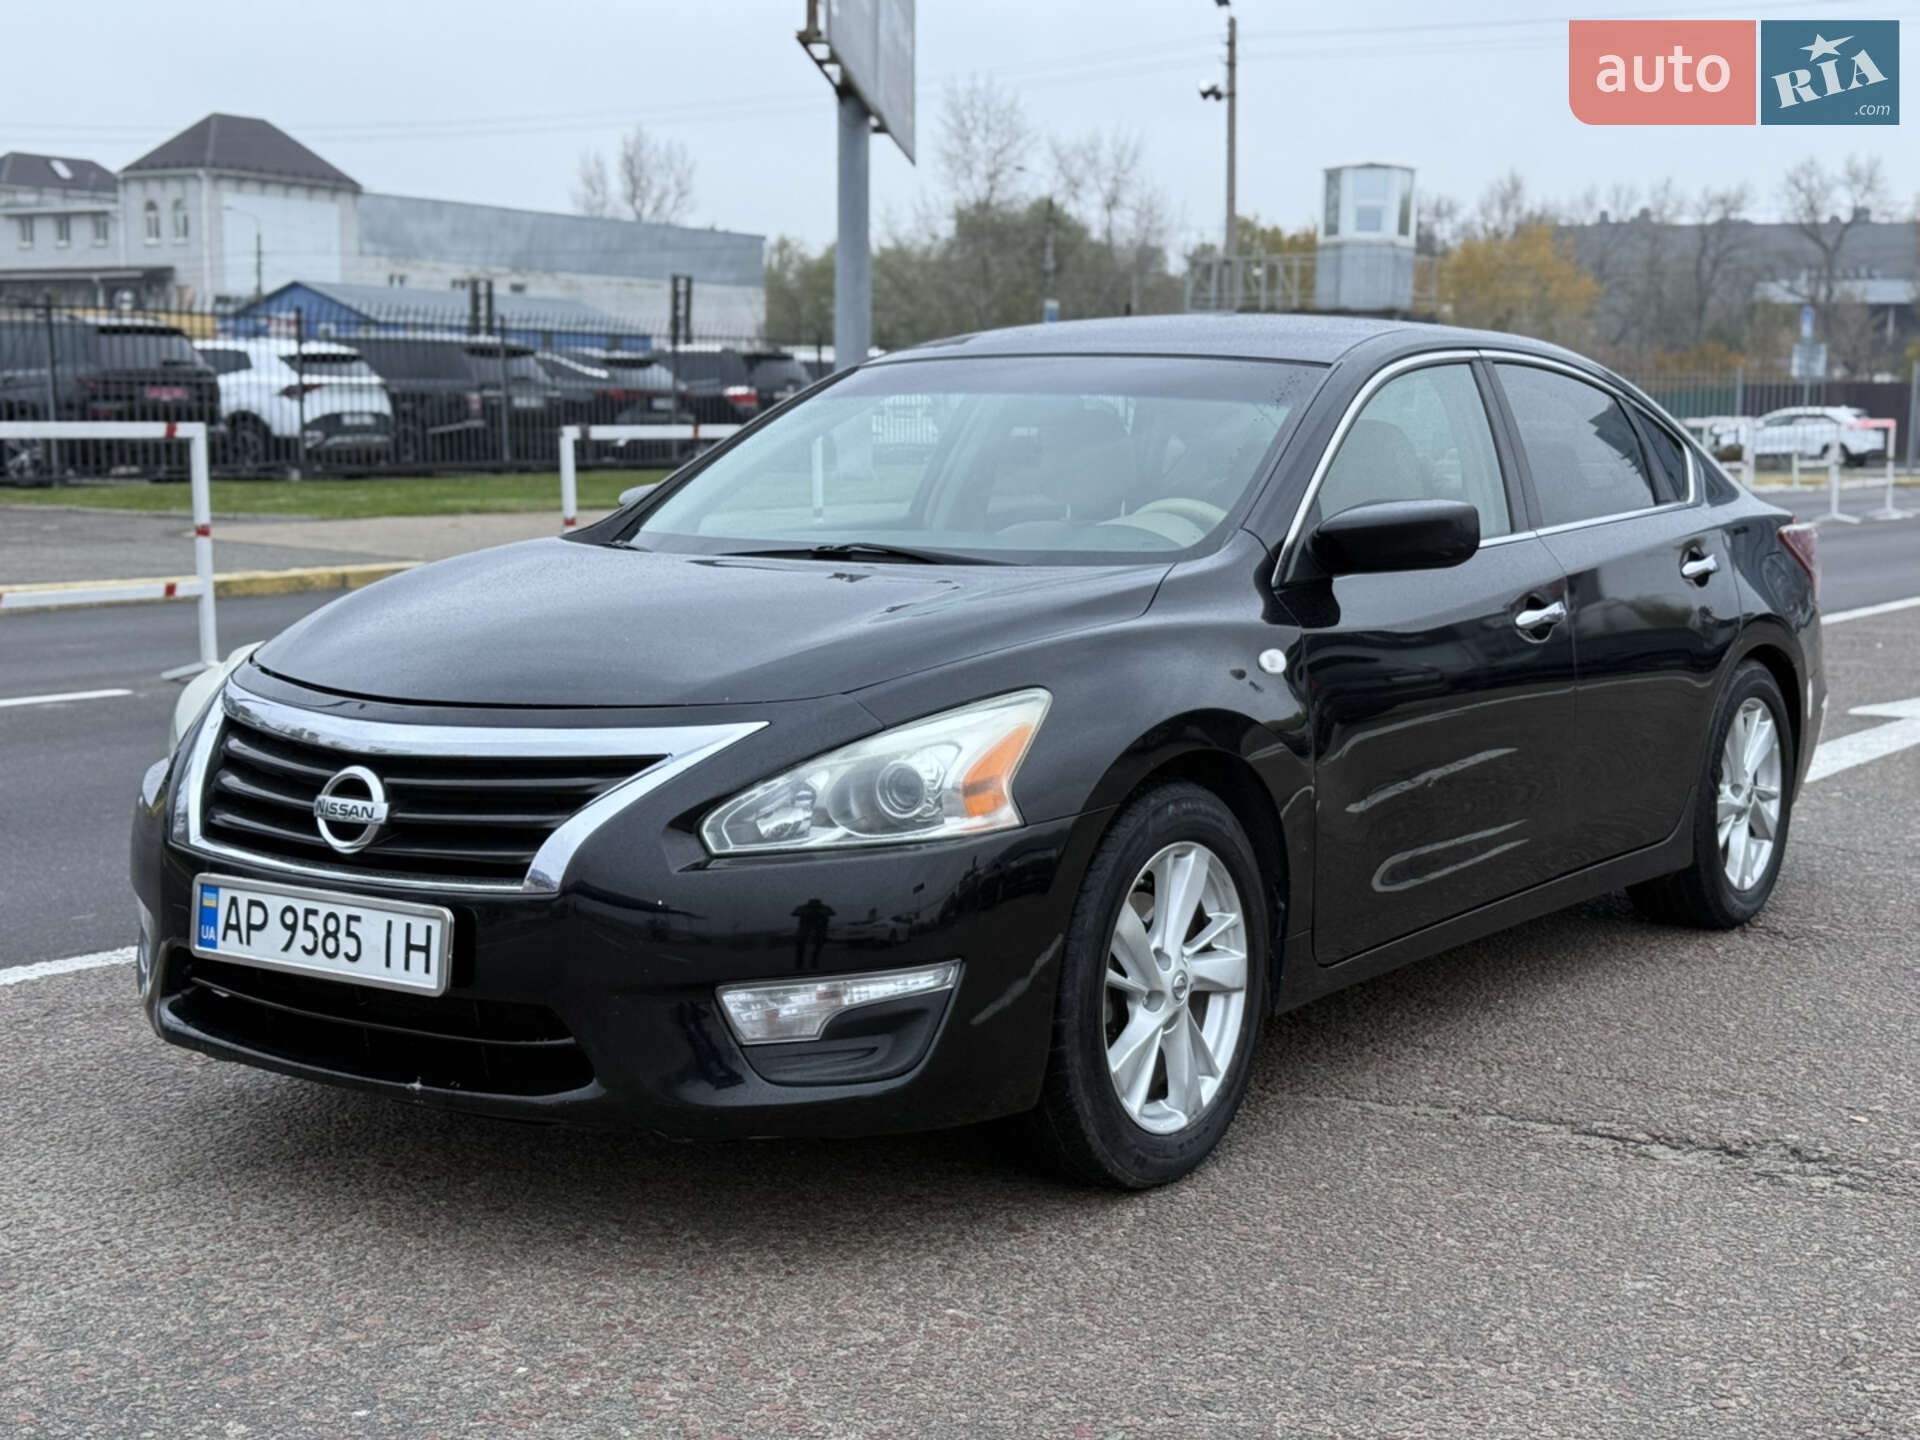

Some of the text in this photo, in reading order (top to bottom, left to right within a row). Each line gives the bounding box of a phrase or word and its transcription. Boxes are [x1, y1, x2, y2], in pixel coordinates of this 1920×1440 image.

[316, 798, 375, 819] NISSAN
[201, 924, 217, 942] UA
[222, 895, 433, 974] AP 9585 IH
